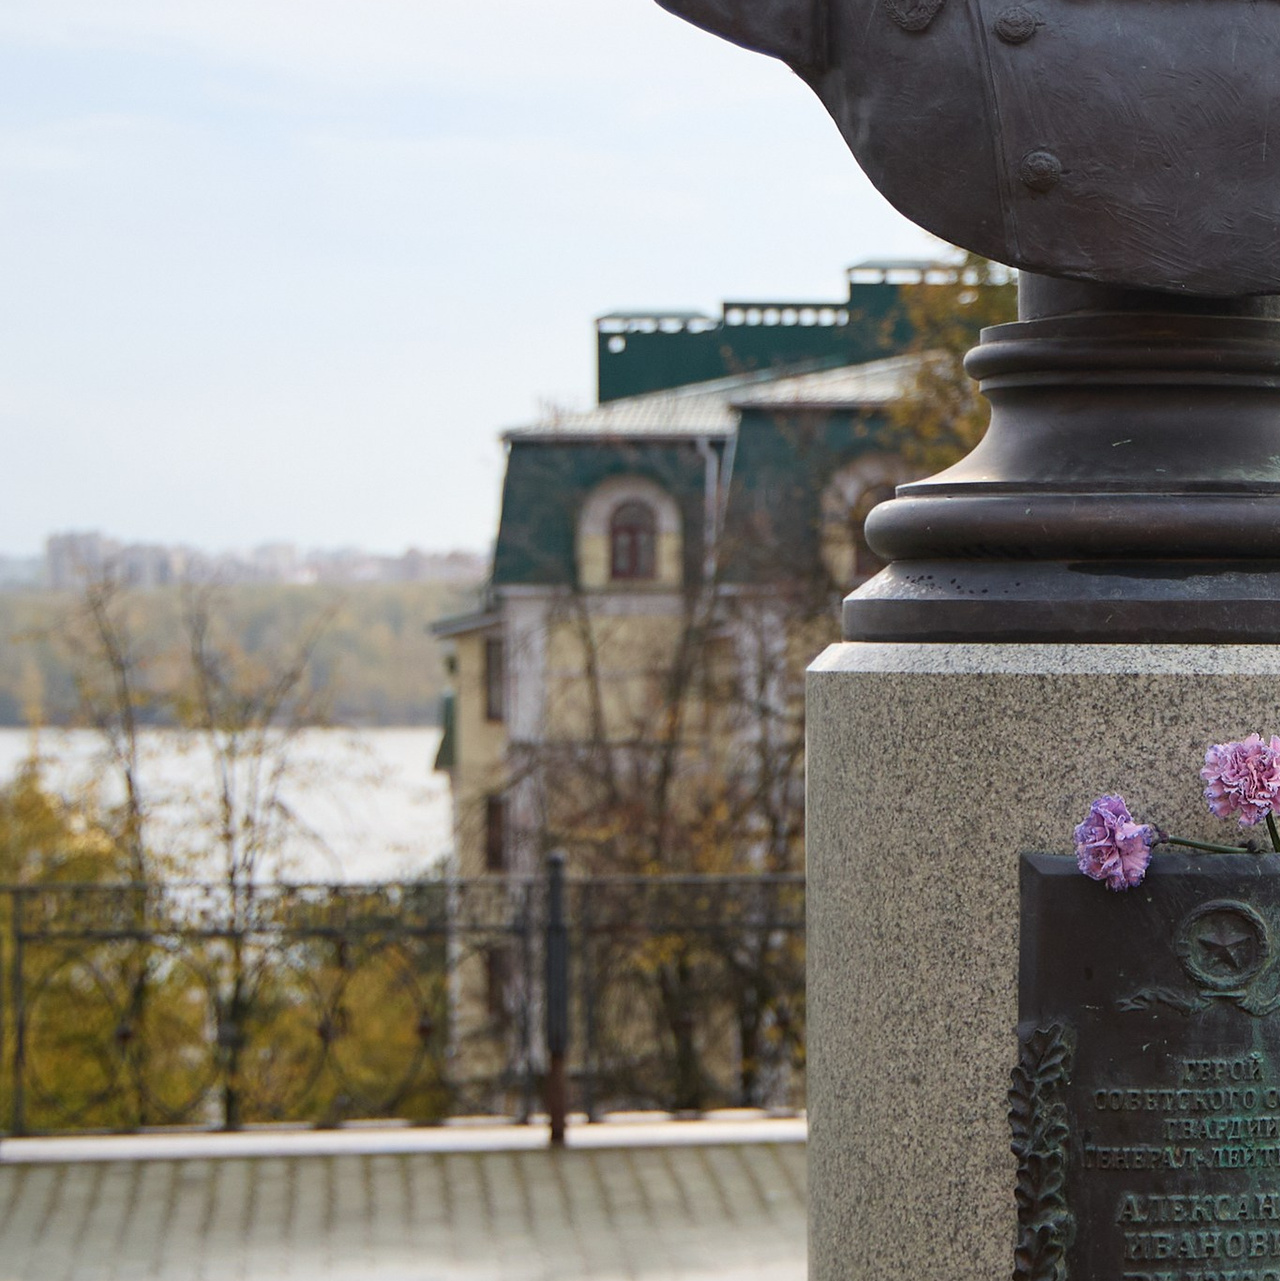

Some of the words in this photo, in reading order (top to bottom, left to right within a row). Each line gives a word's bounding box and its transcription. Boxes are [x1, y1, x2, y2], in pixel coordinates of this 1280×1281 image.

[1182, 1051, 1264, 1081] ГЕРОЙ
[1093, 1088, 1258, 1111] СОВЕТСКОГО
[1163, 1117, 1280, 1140] ГВАРДИИ
